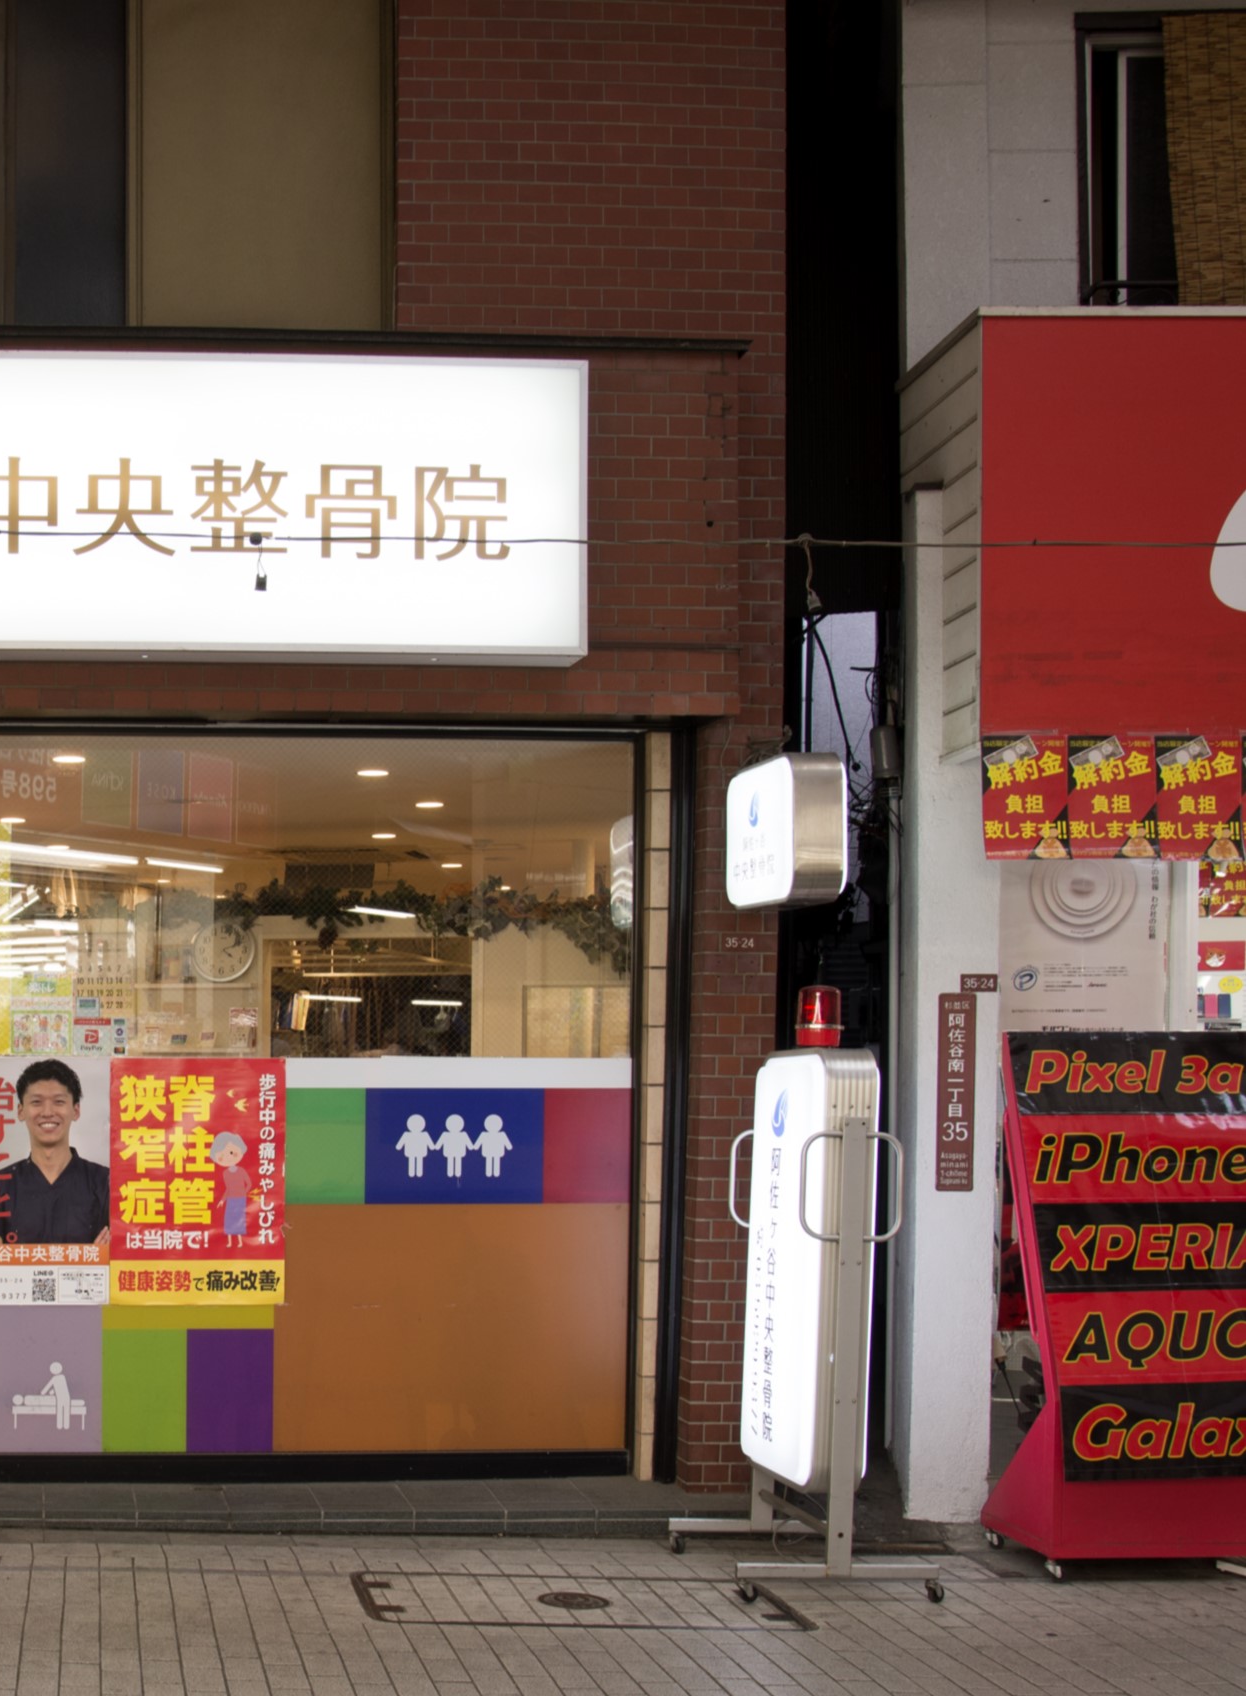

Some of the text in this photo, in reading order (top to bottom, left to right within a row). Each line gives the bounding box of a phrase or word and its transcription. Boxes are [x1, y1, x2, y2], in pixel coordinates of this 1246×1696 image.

[987, 750, 1064, 790] 解約金
[1073, 751, 1151, 790] 解約金
[1160, 751, 1237, 791] 解約金
[1006, 794, 1044, 814] 負担
[1091, 794, 1131, 814] 負担
[1178, 795, 1217, 815] 負担
[724, 937, 755, 949] 35-24
[963, 977, 994, 989] 35-24
[947, 1013, 966, 1118] 阿佐谷南一丁目
[1024, 1049, 1244, 1095] Pixel 3a
[119, 1074, 166, 1225] 狭窄症
[168, 1074, 216, 1225] 脊柱管
[941, 1121, 968, 1142] 35
[258, 1073, 277, 1246] 歩行中の痛みやしびれ
[1033, 1131, 1246, 1184] iPhone
[126, 1229, 209, 1250] は当院で!
